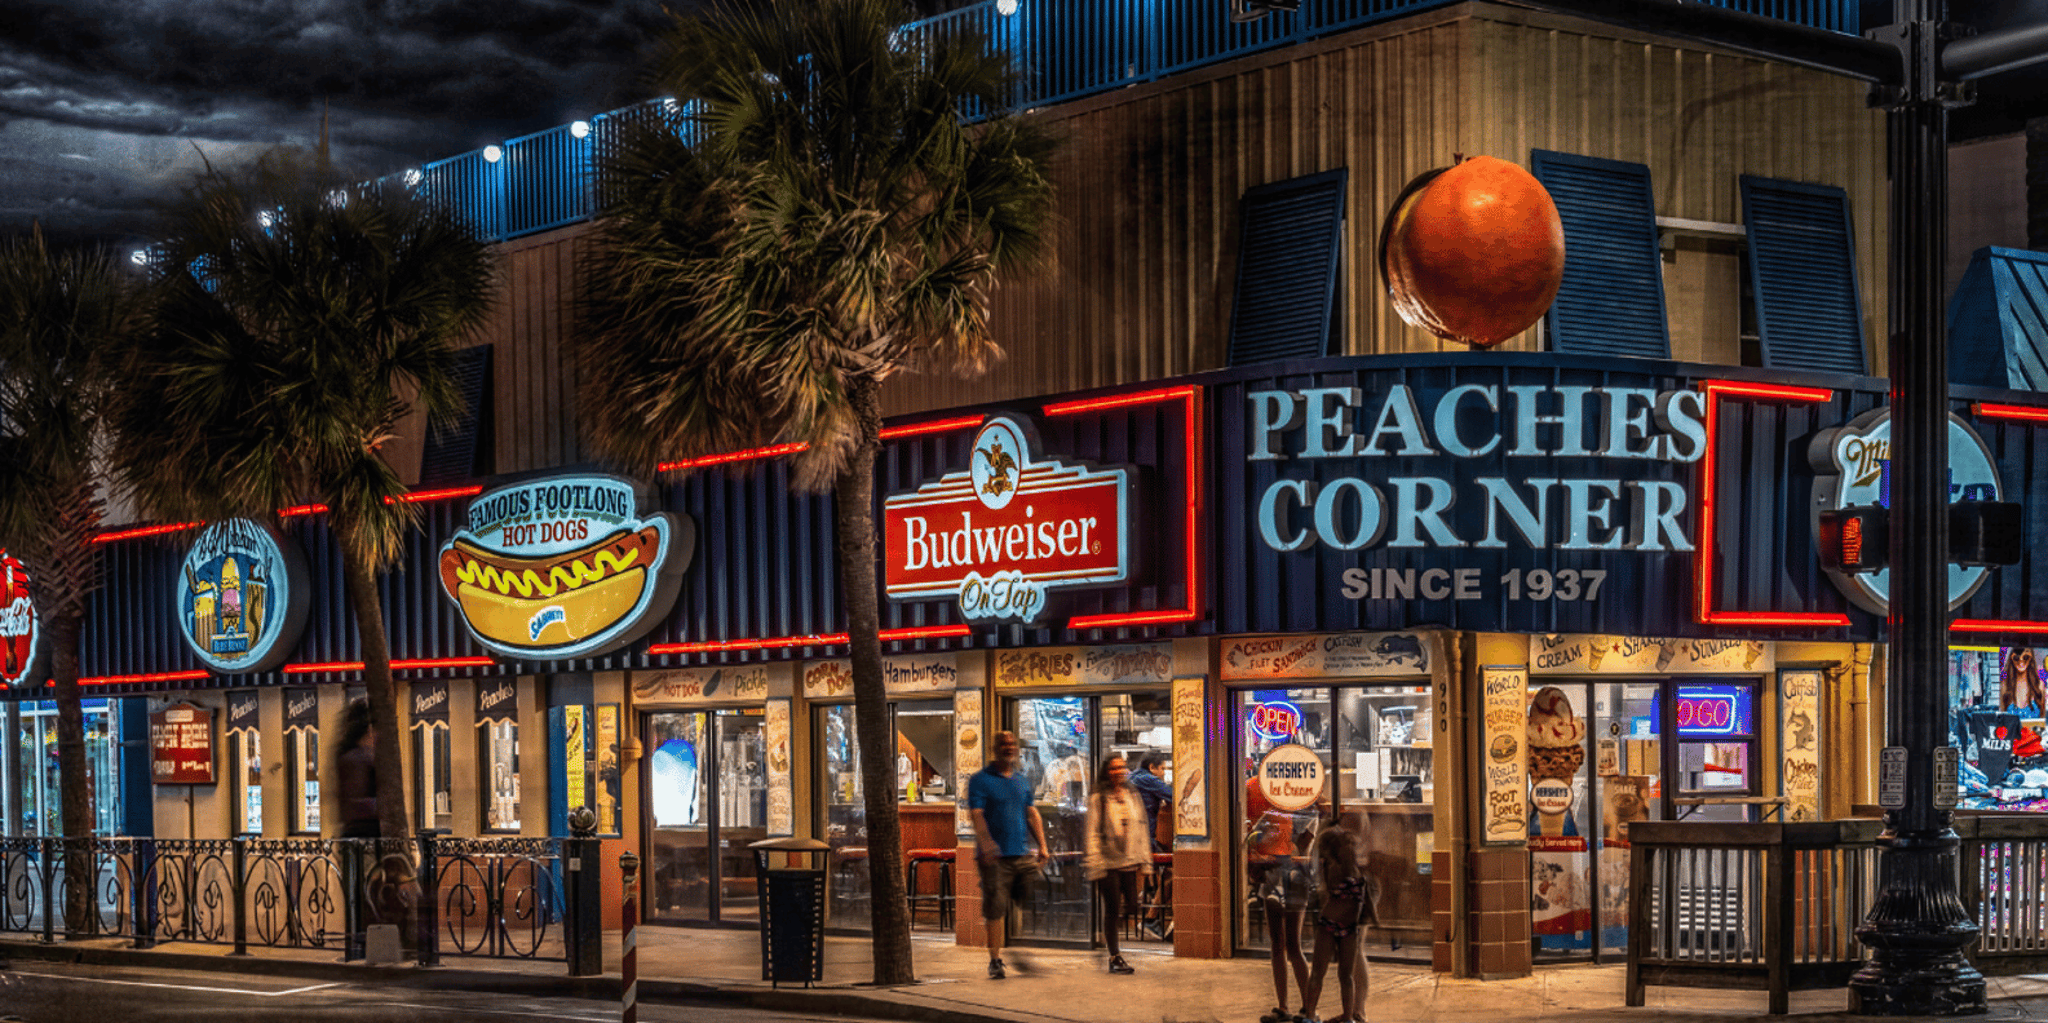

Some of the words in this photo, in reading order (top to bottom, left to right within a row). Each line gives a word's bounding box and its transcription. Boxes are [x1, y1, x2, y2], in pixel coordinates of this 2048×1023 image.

[1246, 384, 1707, 462] PEACHES
[470, 488, 531, 533] FAMOUS
[535, 484, 628, 517] FOOTLONG
[1258, 476, 1696, 552] CORNER
[502, 523, 537, 547] HOT
[541, 519, 589, 543] DOGS
[903, 505, 1097, 571] Budweiser
[960, 578, 989, 611] On
[991, 576, 1038, 616] Tap
[1341, 568, 1482, 600] SINCE
[1500, 568, 1607, 601] 1937
[1537, 644, 1583, 669] CREAM
[1539, 634, 1565, 652] ICE
[806, 662, 840, 689] CORN
[884, 661, 957, 686] Hamburgers
[1028, 651, 1074, 682] FRIES
[734, 668, 767, 697] Pickle
[1486, 674, 1521, 696] WORLD
[230, 696, 258, 722] Peaches
[287, 692, 316, 720] Peaches
[415, 686, 447, 714] Peaches
[480, 682, 514, 711] Peaches
[1438, 682, 1447, 733] 900
[1255, 704, 1298, 736] OPEN
[1697, 700, 1730, 727] GO
[1981, 737, 2011, 750] MILFS
[1989, 726, 1997, 739] I
[1265, 761, 1316, 779] HERSHEY'S
[1487, 763, 1519, 780] WORLD
[1269, 781, 1282, 797] Ice
[1283, 781, 1314, 797] Cream
[1489, 789, 1518, 806] FOOT
[1493, 802, 1523, 818] LONG
